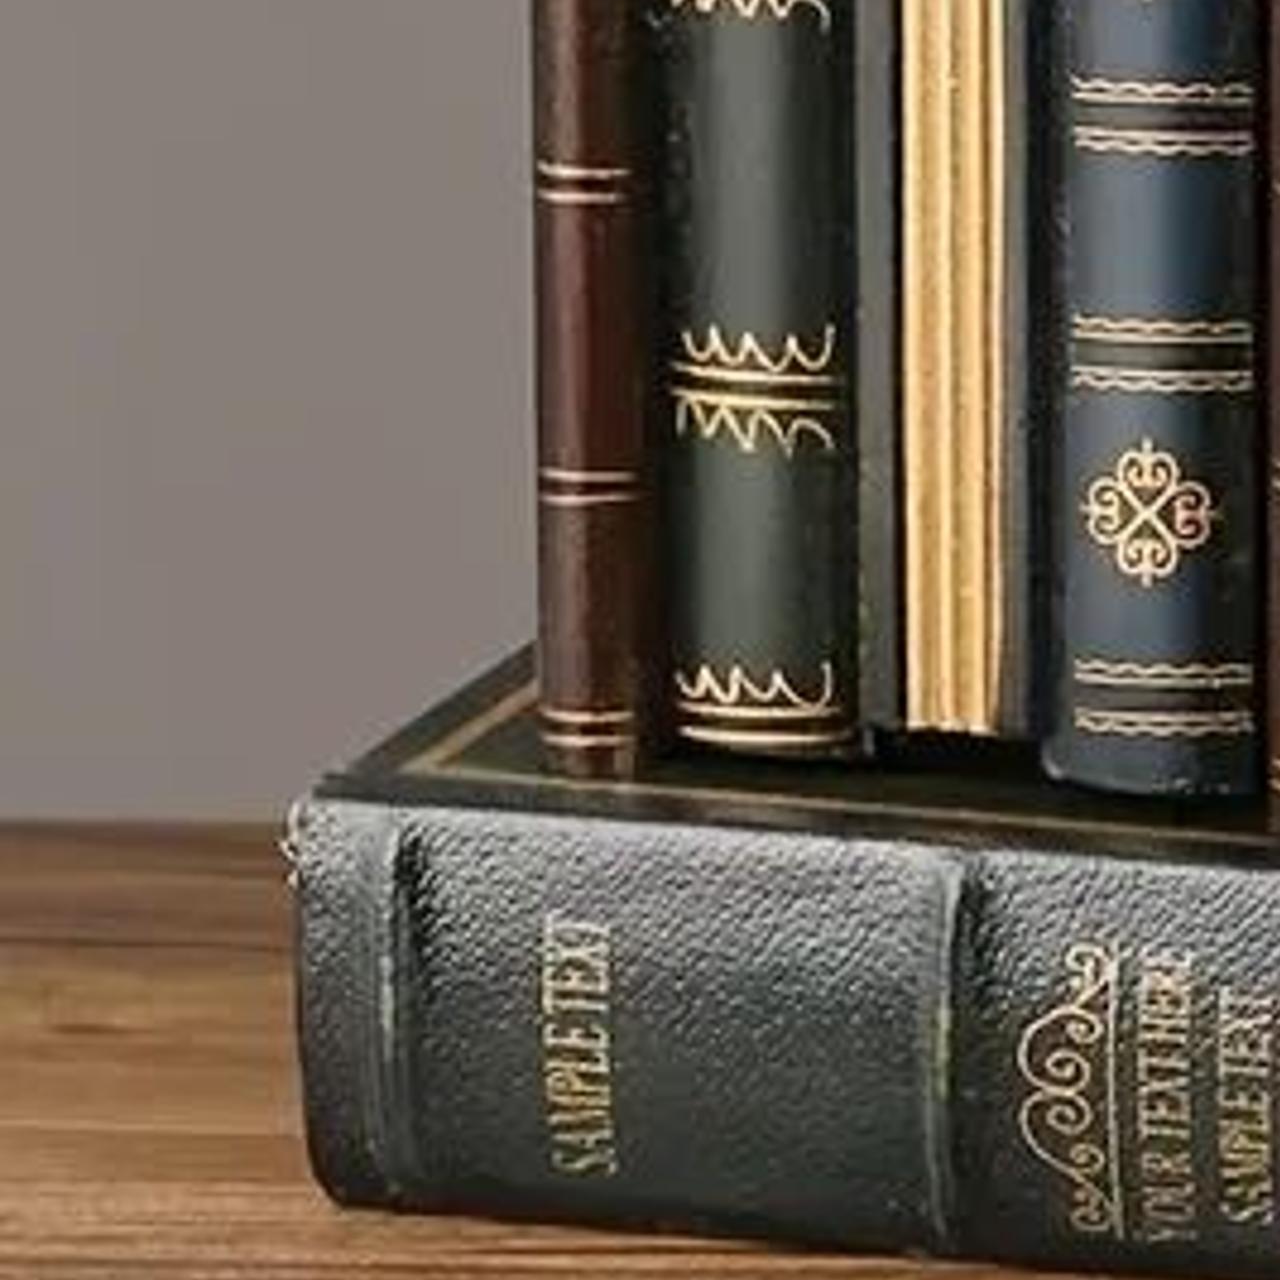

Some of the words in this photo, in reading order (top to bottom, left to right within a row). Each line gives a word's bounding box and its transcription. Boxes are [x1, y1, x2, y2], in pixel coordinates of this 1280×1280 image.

[542, 912, 611, 1016] TEXT
[1138, 946, 1196, 1042] HERE
[1217, 984, 1272, 1080] TEXT
[543, 1022, 617, 1175] SAMPLE
[1138, 1043, 1192, 1140] TEXT
[1138, 1152, 1197, 1244] YOUR
[1217, 1092, 1274, 1225] SAMPLE
